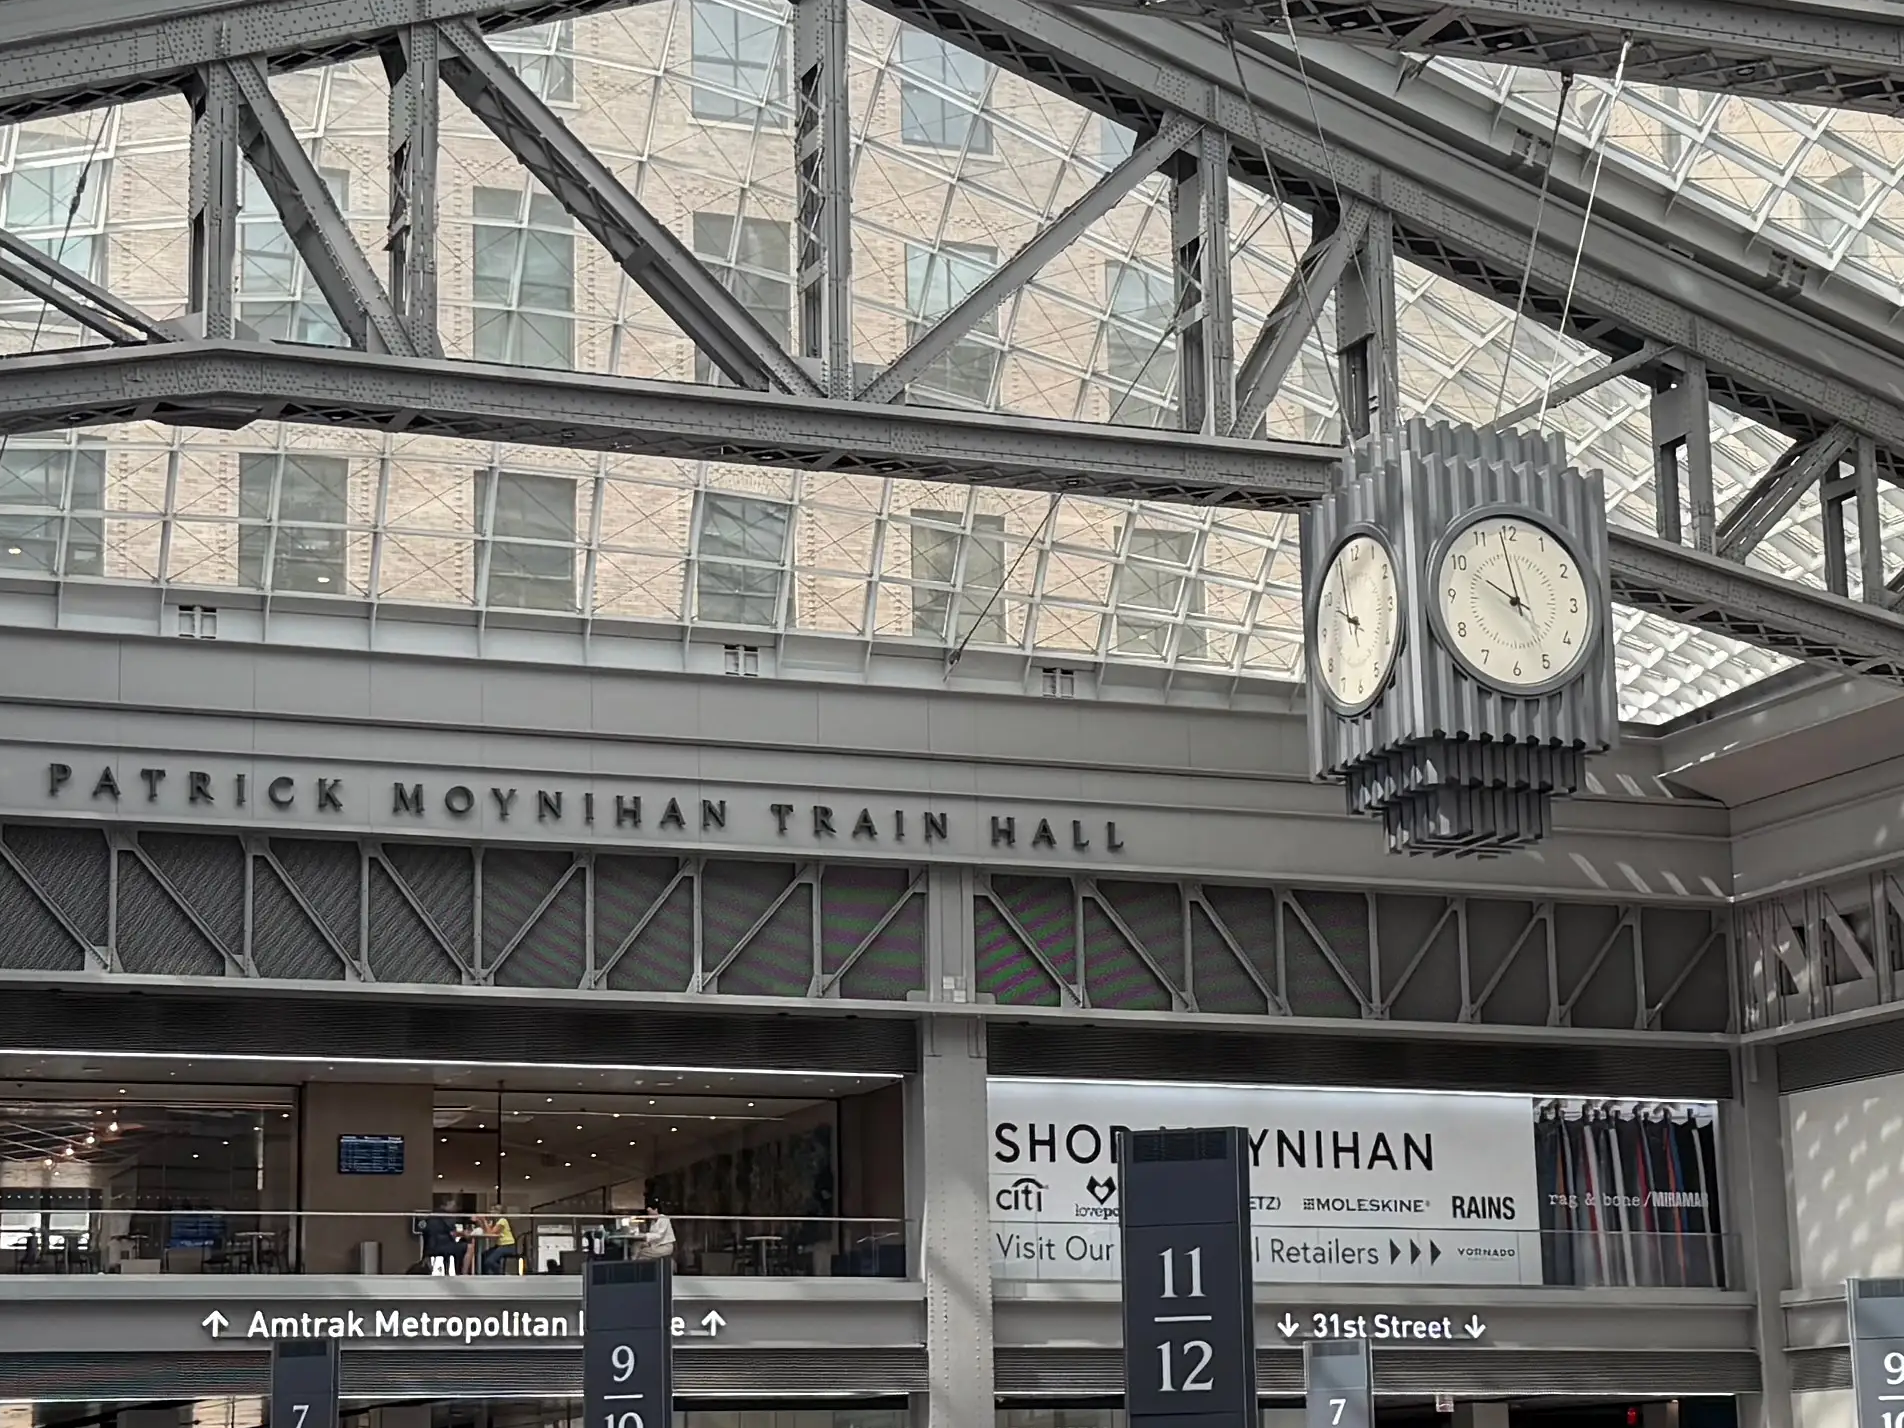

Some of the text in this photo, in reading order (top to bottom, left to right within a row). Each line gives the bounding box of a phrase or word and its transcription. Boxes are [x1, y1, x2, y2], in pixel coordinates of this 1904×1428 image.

[1473, 531, 1487, 547] 11
[1502, 525, 1517, 542] 12
[1538, 537, 1545, 552] 1
[1451, 554, 1467, 571] 10
[1559, 563, 1569, 579] 2
[1447, 588, 1457, 604] 9
[1569, 598, 1579, 614] 3
[1457, 621, 1467, 638] 8
[1562, 630, 1572, 646] 4
[1481, 649, 1490, 665] 7
[1541, 654, 1551, 670] 5
[1512, 660, 1522, 677] 6
[49, 762, 344, 811] PATRICK
[393, 781, 728, 829] MOYNIHAN
[771, 803, 949, 841] TRAIN
[991, 816, 1125, 851] HALL
[1249, 1128, 1433, 1171] YNIHAN
[996, 1177, 1044, 1213] citi
[1548, 1193, 1578, 1208] rag
[1585, 1192, 1596, 1206] &
[1602, 1192, 1641, 1207] bone
[1451, 1195, 1516, 1220] RAINS
[996, 1232, 1114, 1261] Visit Our
[1271, 1238, 1380, 1265] Retailers
[1158, 1247, 1208, 1299] 11
[247, 1310, 365, 1338] Amtrak
[375, 1310, 569, 1344] Metropolitan
[1312, 1312, 1453, 1339] 31st Street
[611, 1345, 635, 1382] 9
[1156, 1340, 1215, 1392] 12
[1329, 1398, 1347, 1426] 7
